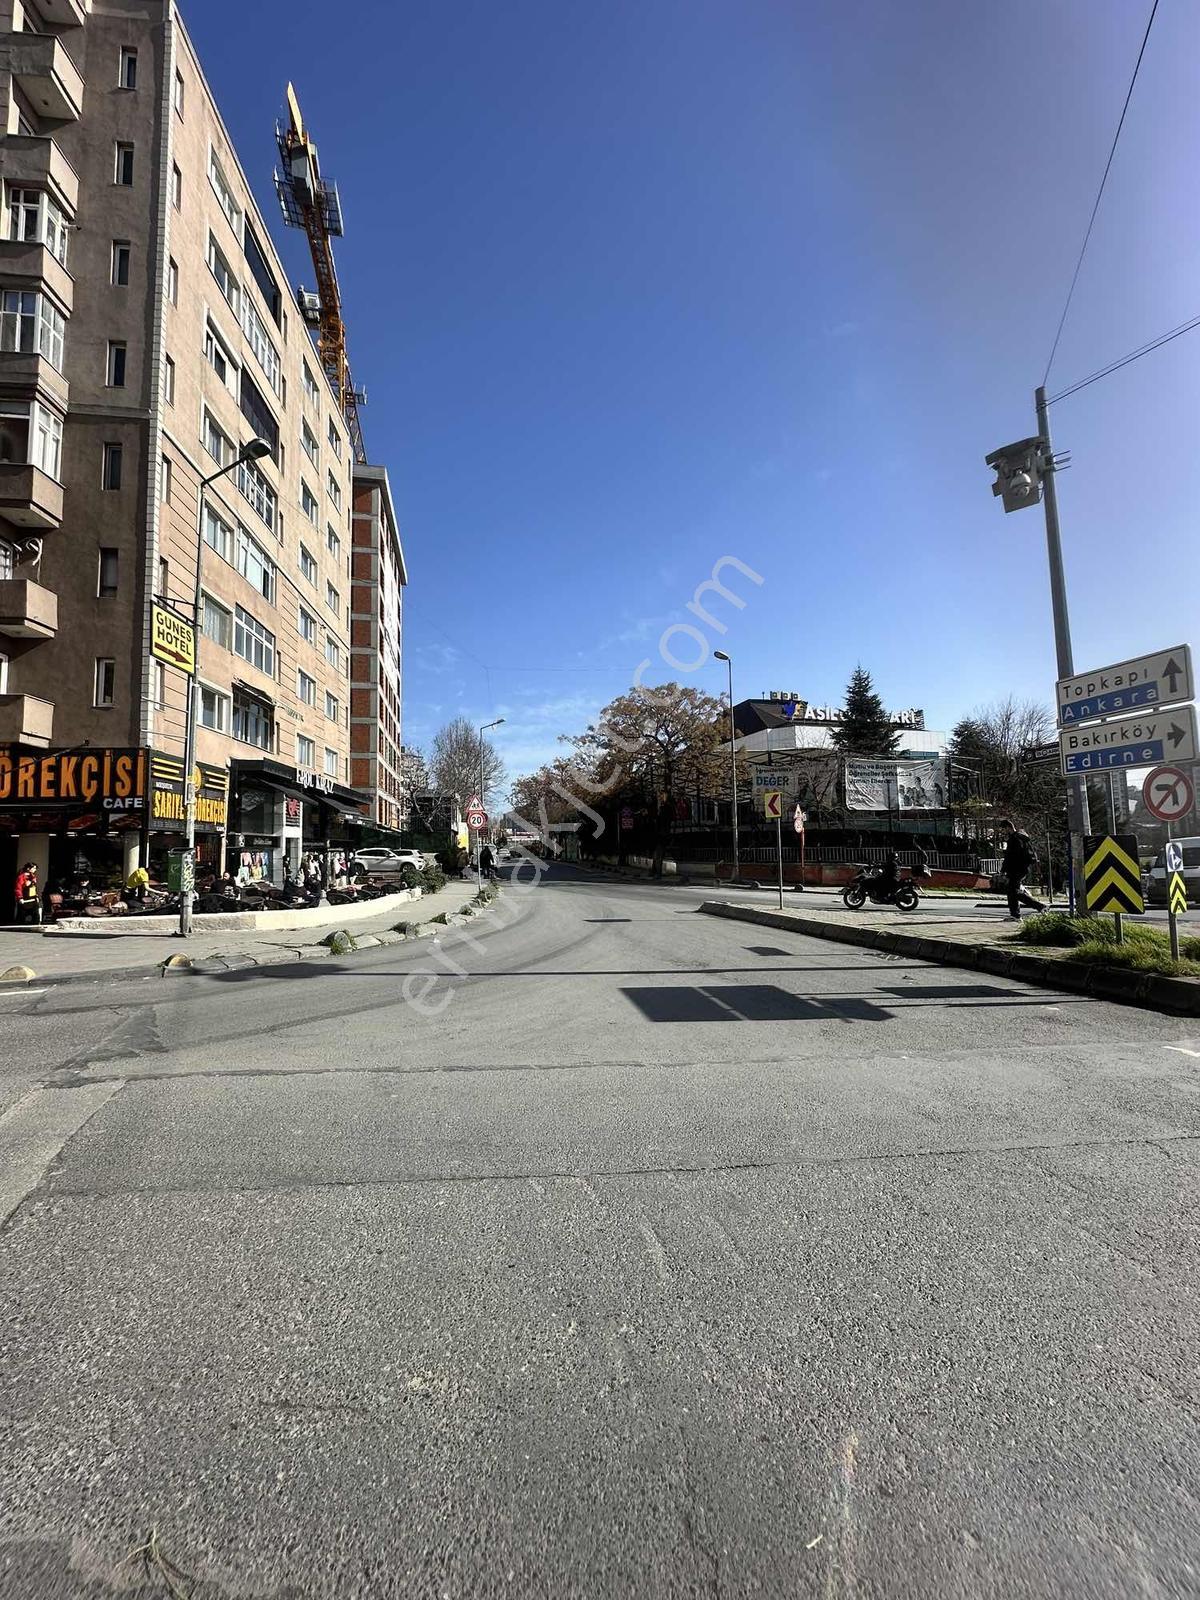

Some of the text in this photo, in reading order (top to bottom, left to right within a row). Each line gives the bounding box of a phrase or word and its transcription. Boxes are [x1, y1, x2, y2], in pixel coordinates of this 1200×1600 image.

[157, 626, 192, 657] HOTEL
[1063, 668, 1148, 698] Topkapı
[1064, 688, 1157, 720] Ankara
[1069, 724, 1157, 749] Bakırköy
[1067, 748, 1153, 770] Edirne
[756, 773, 790, 786] DEĞER
[103, 797, 144, 809] CAFE
[153, 790, 185, 820] SARIYE
[471, 816, 482, 825] 20
